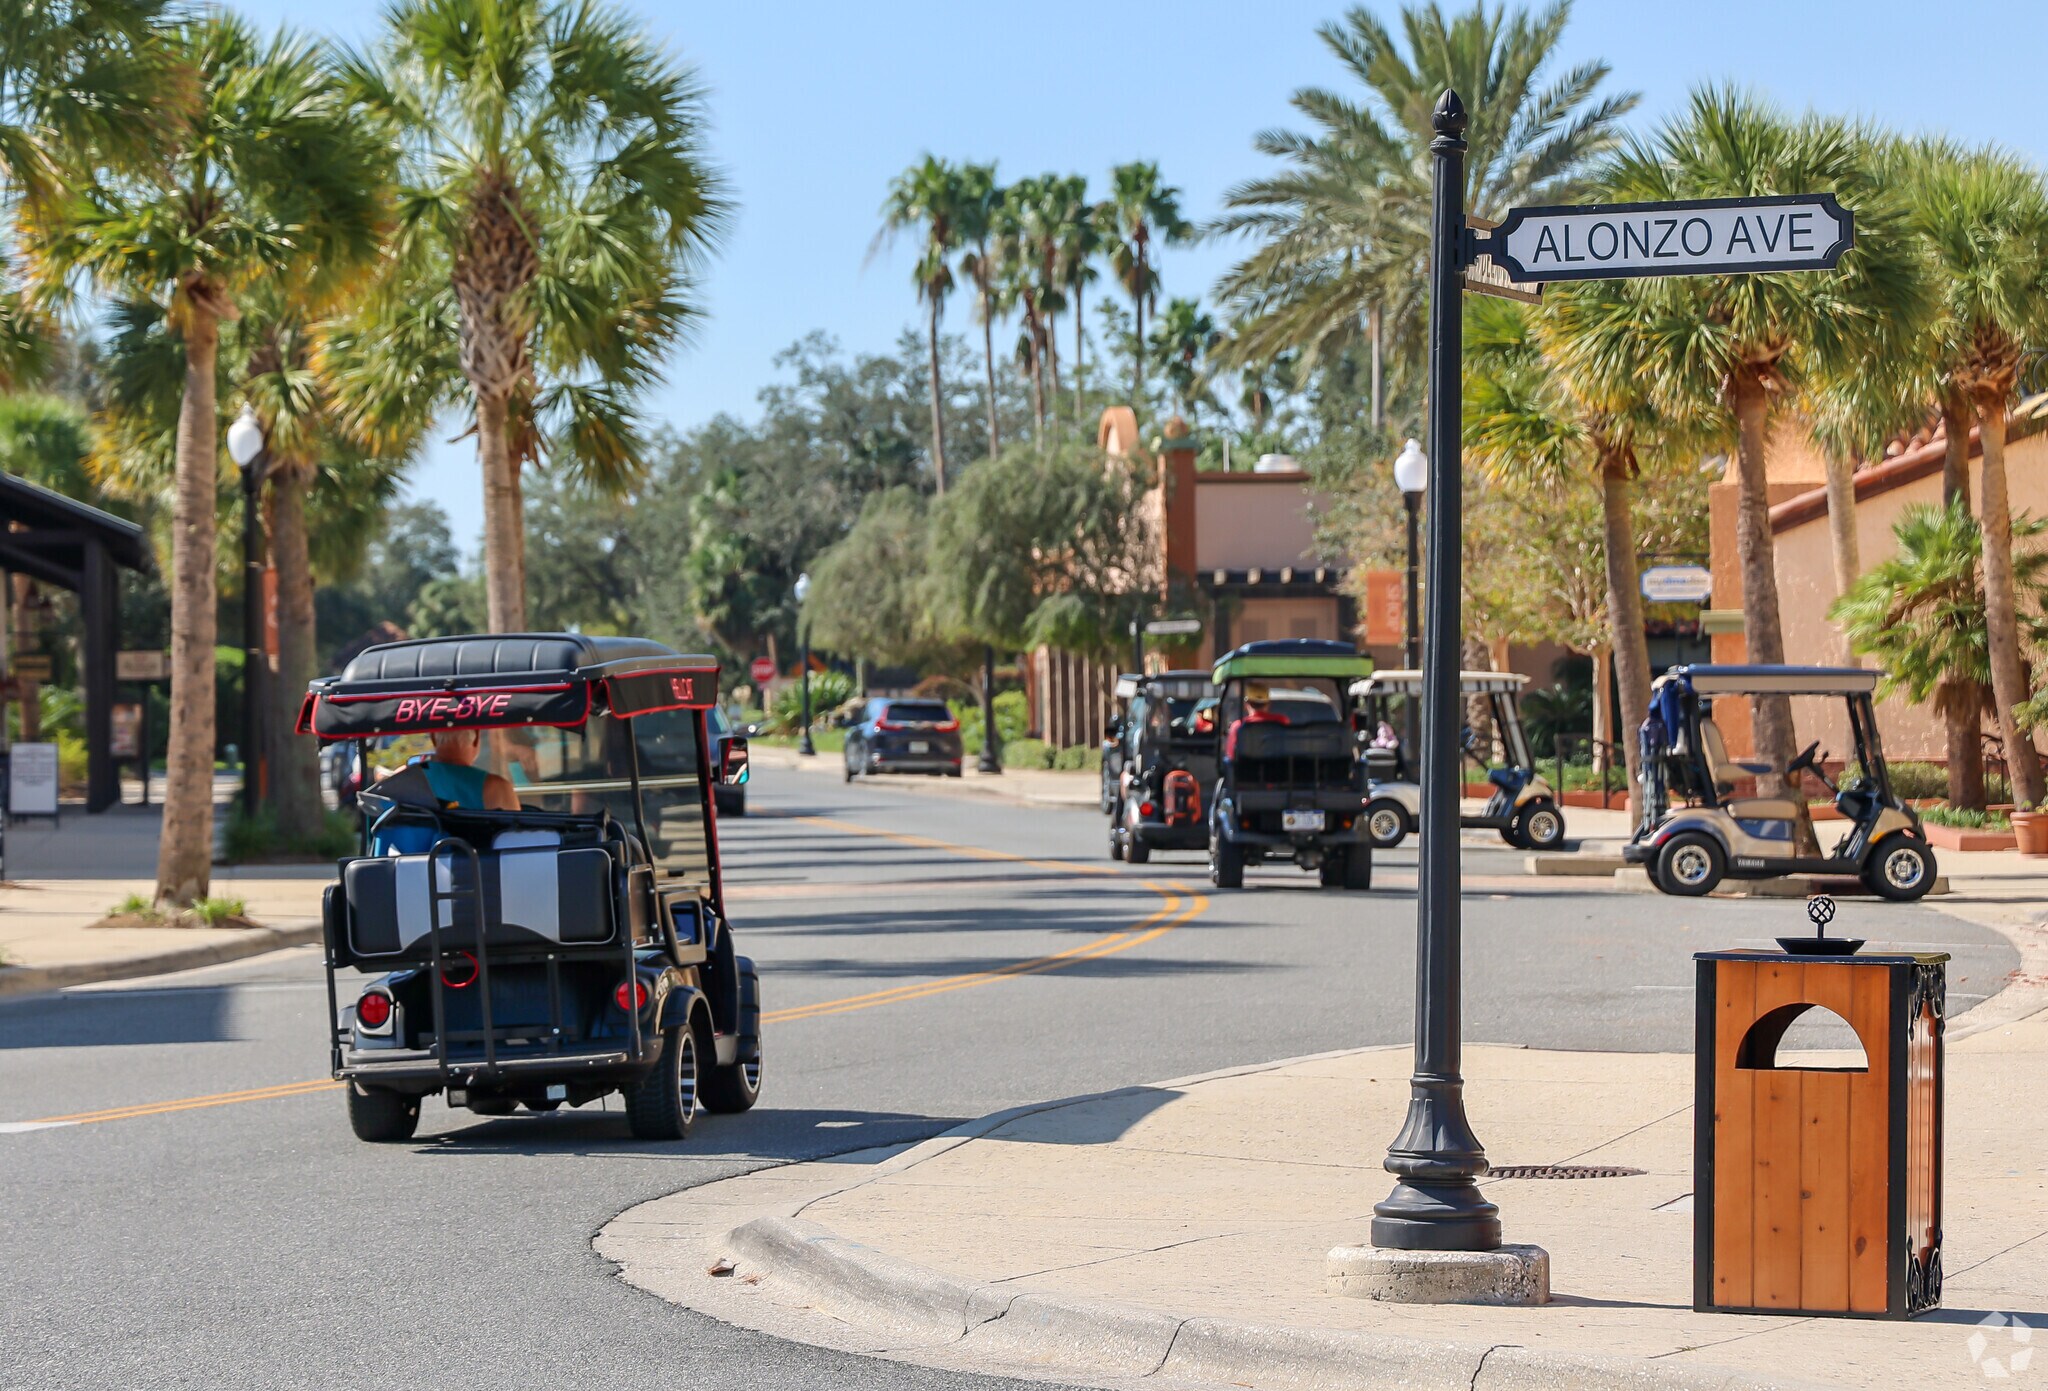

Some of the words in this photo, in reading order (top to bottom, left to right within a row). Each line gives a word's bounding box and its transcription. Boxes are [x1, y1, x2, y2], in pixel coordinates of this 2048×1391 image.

[1533, 218, 1713, 263] ALONZO
[1727, 213, 1814, 255] AVE
[752, 663, 774, 675] STOP
[395, 694, 512, 723] BYE-BYE
[1737, 858, 1765, 868] YAMAHA
